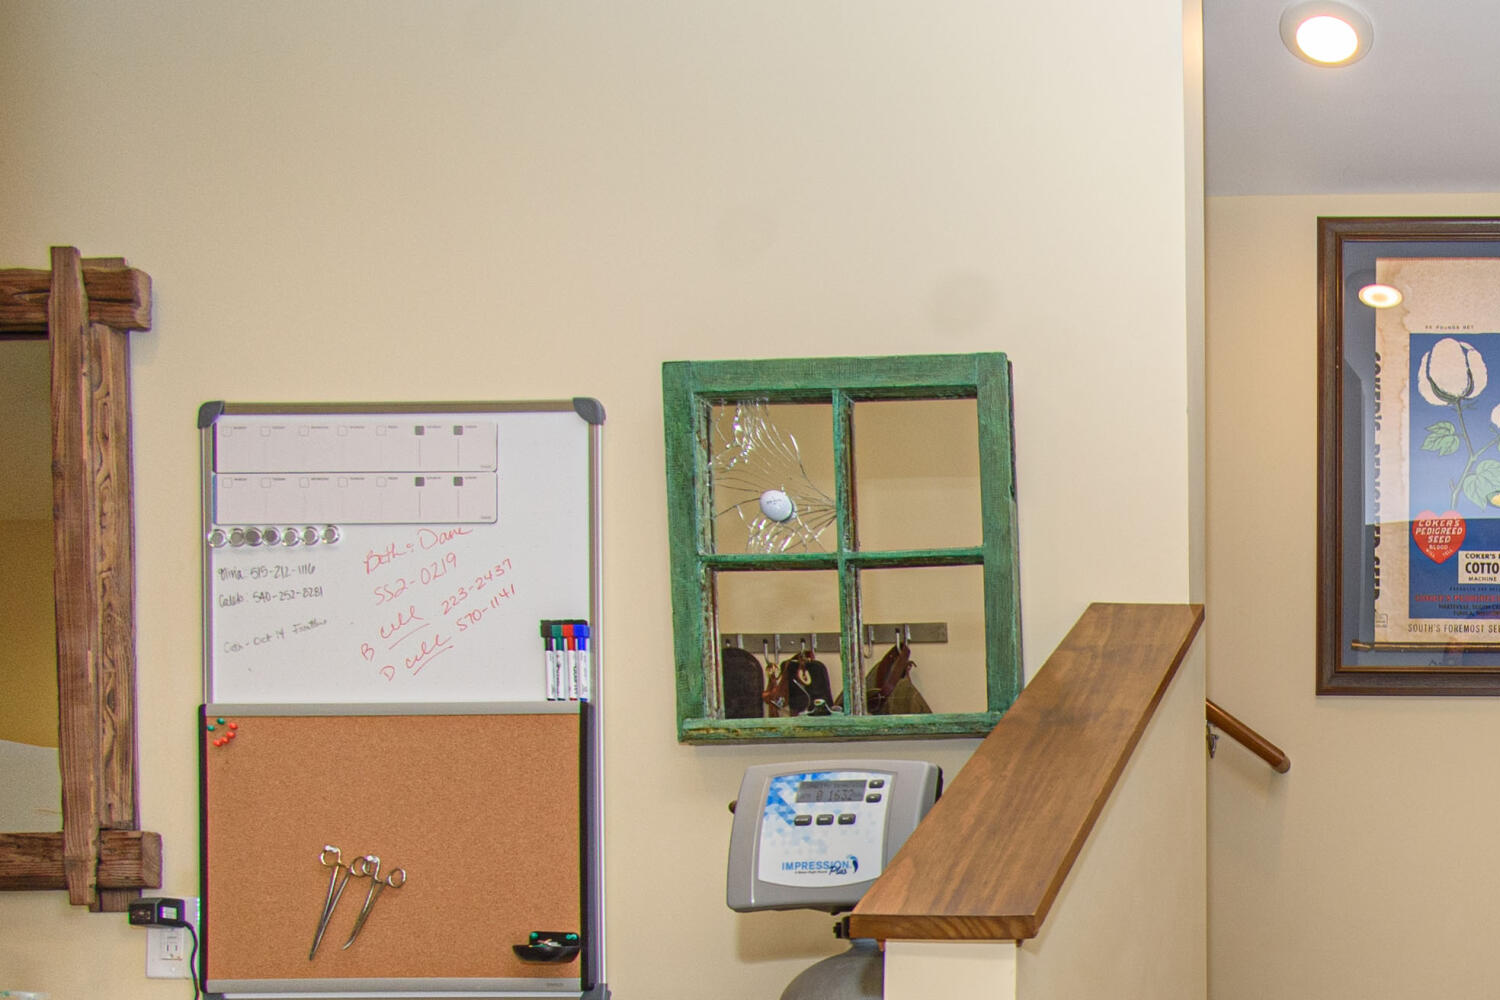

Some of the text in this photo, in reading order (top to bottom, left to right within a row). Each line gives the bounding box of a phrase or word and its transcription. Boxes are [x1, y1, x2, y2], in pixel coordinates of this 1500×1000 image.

[1415, 527, 1463, 535] PEDIGREED
[1428, 535, 1451, 543] SEED
[1465, 552, 1496, 560] COKER'S
[1408, 624, 1441, 633] SOUTH'S
[1444, 624, 1484, 633] FOREMOST
[781, 860, 850, 871] IMPRESSION
